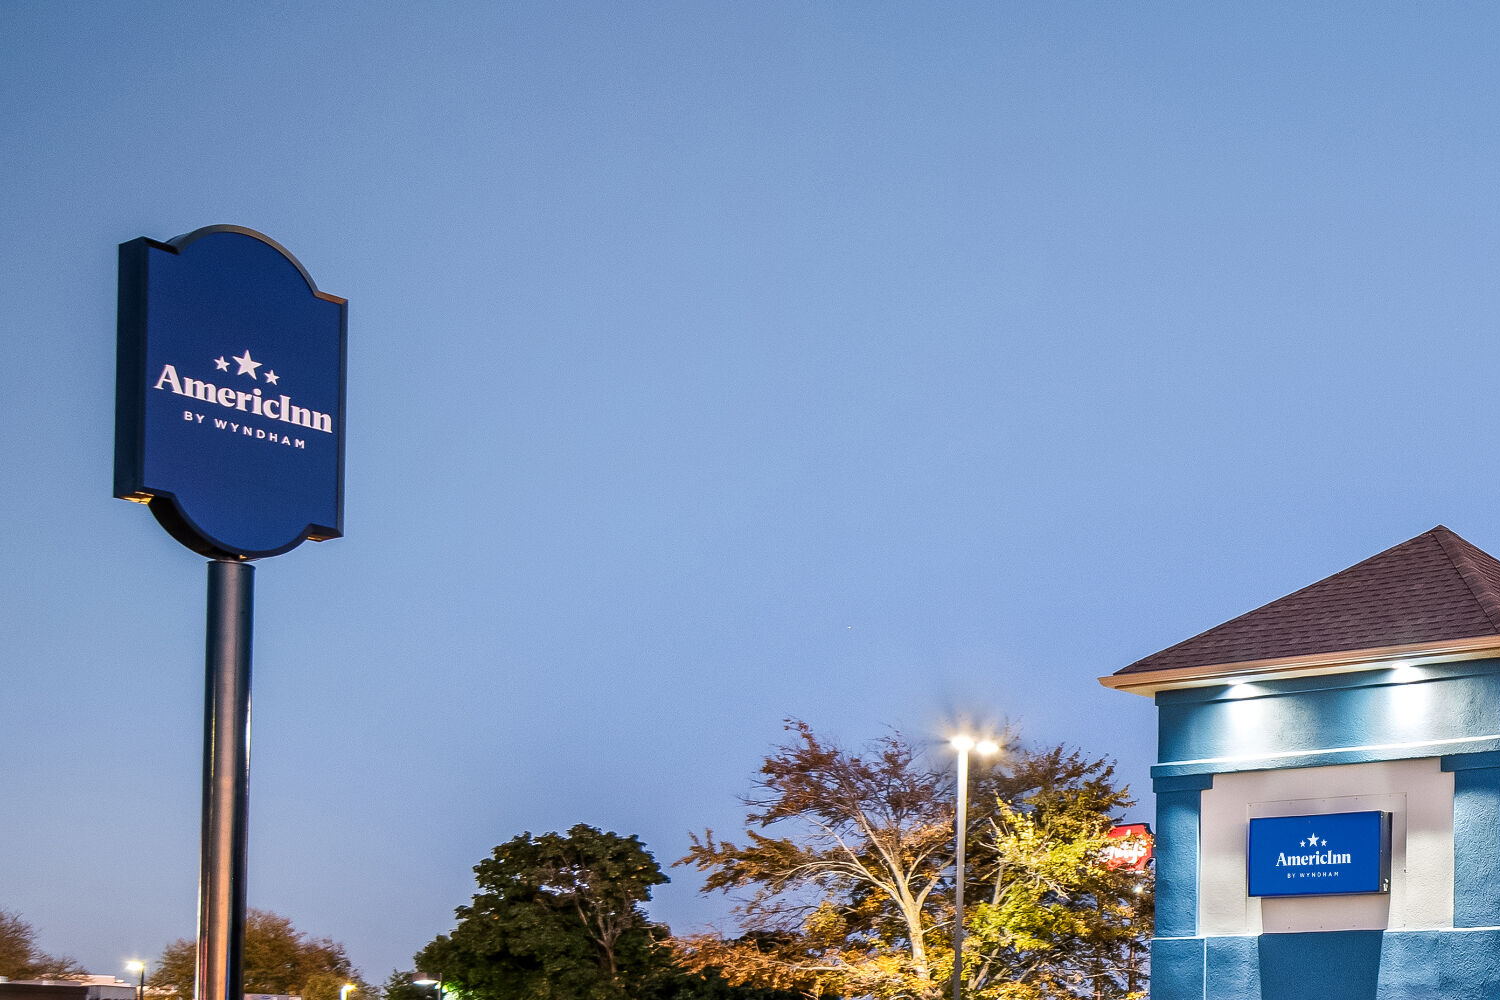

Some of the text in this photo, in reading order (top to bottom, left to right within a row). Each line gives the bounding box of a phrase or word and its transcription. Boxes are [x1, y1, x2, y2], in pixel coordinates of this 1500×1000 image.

[154, 364, 333, 434] AmericInn
[184, 411, 306, 449] BY WYNDHAM
[1275, 850, 1351, 867] AmericInn
